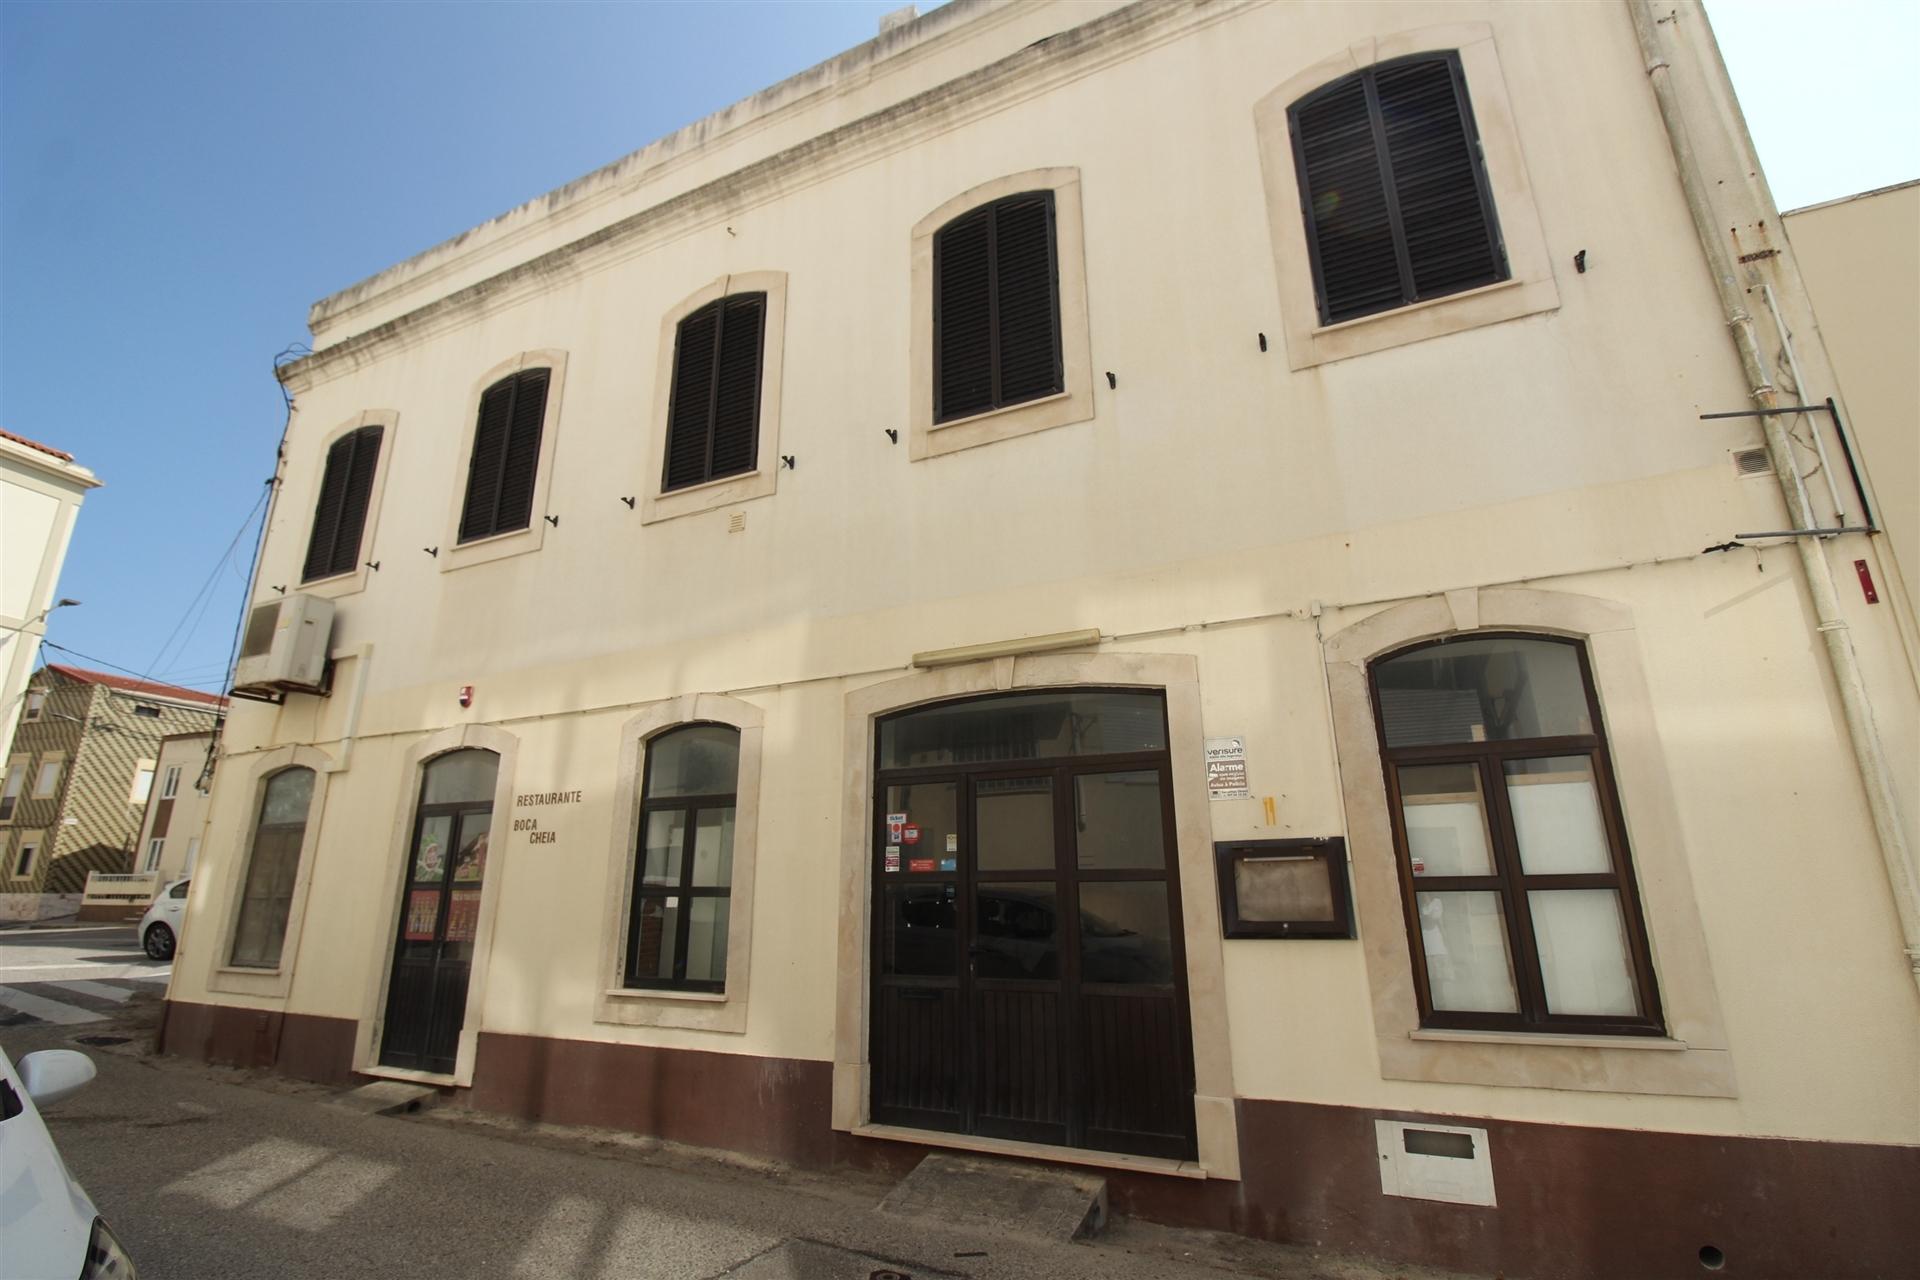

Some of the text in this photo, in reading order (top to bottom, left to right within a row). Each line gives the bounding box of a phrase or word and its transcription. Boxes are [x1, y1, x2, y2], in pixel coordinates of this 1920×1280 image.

[1207, 747, 1243, 755] verisure
[1210, 763, 1244, 772] Alarme
[517, 791, 582, 807] RESTAURANTE
[514, 819, 537, 831] BOCA
[530, 832, 556, 844] CHEIA
